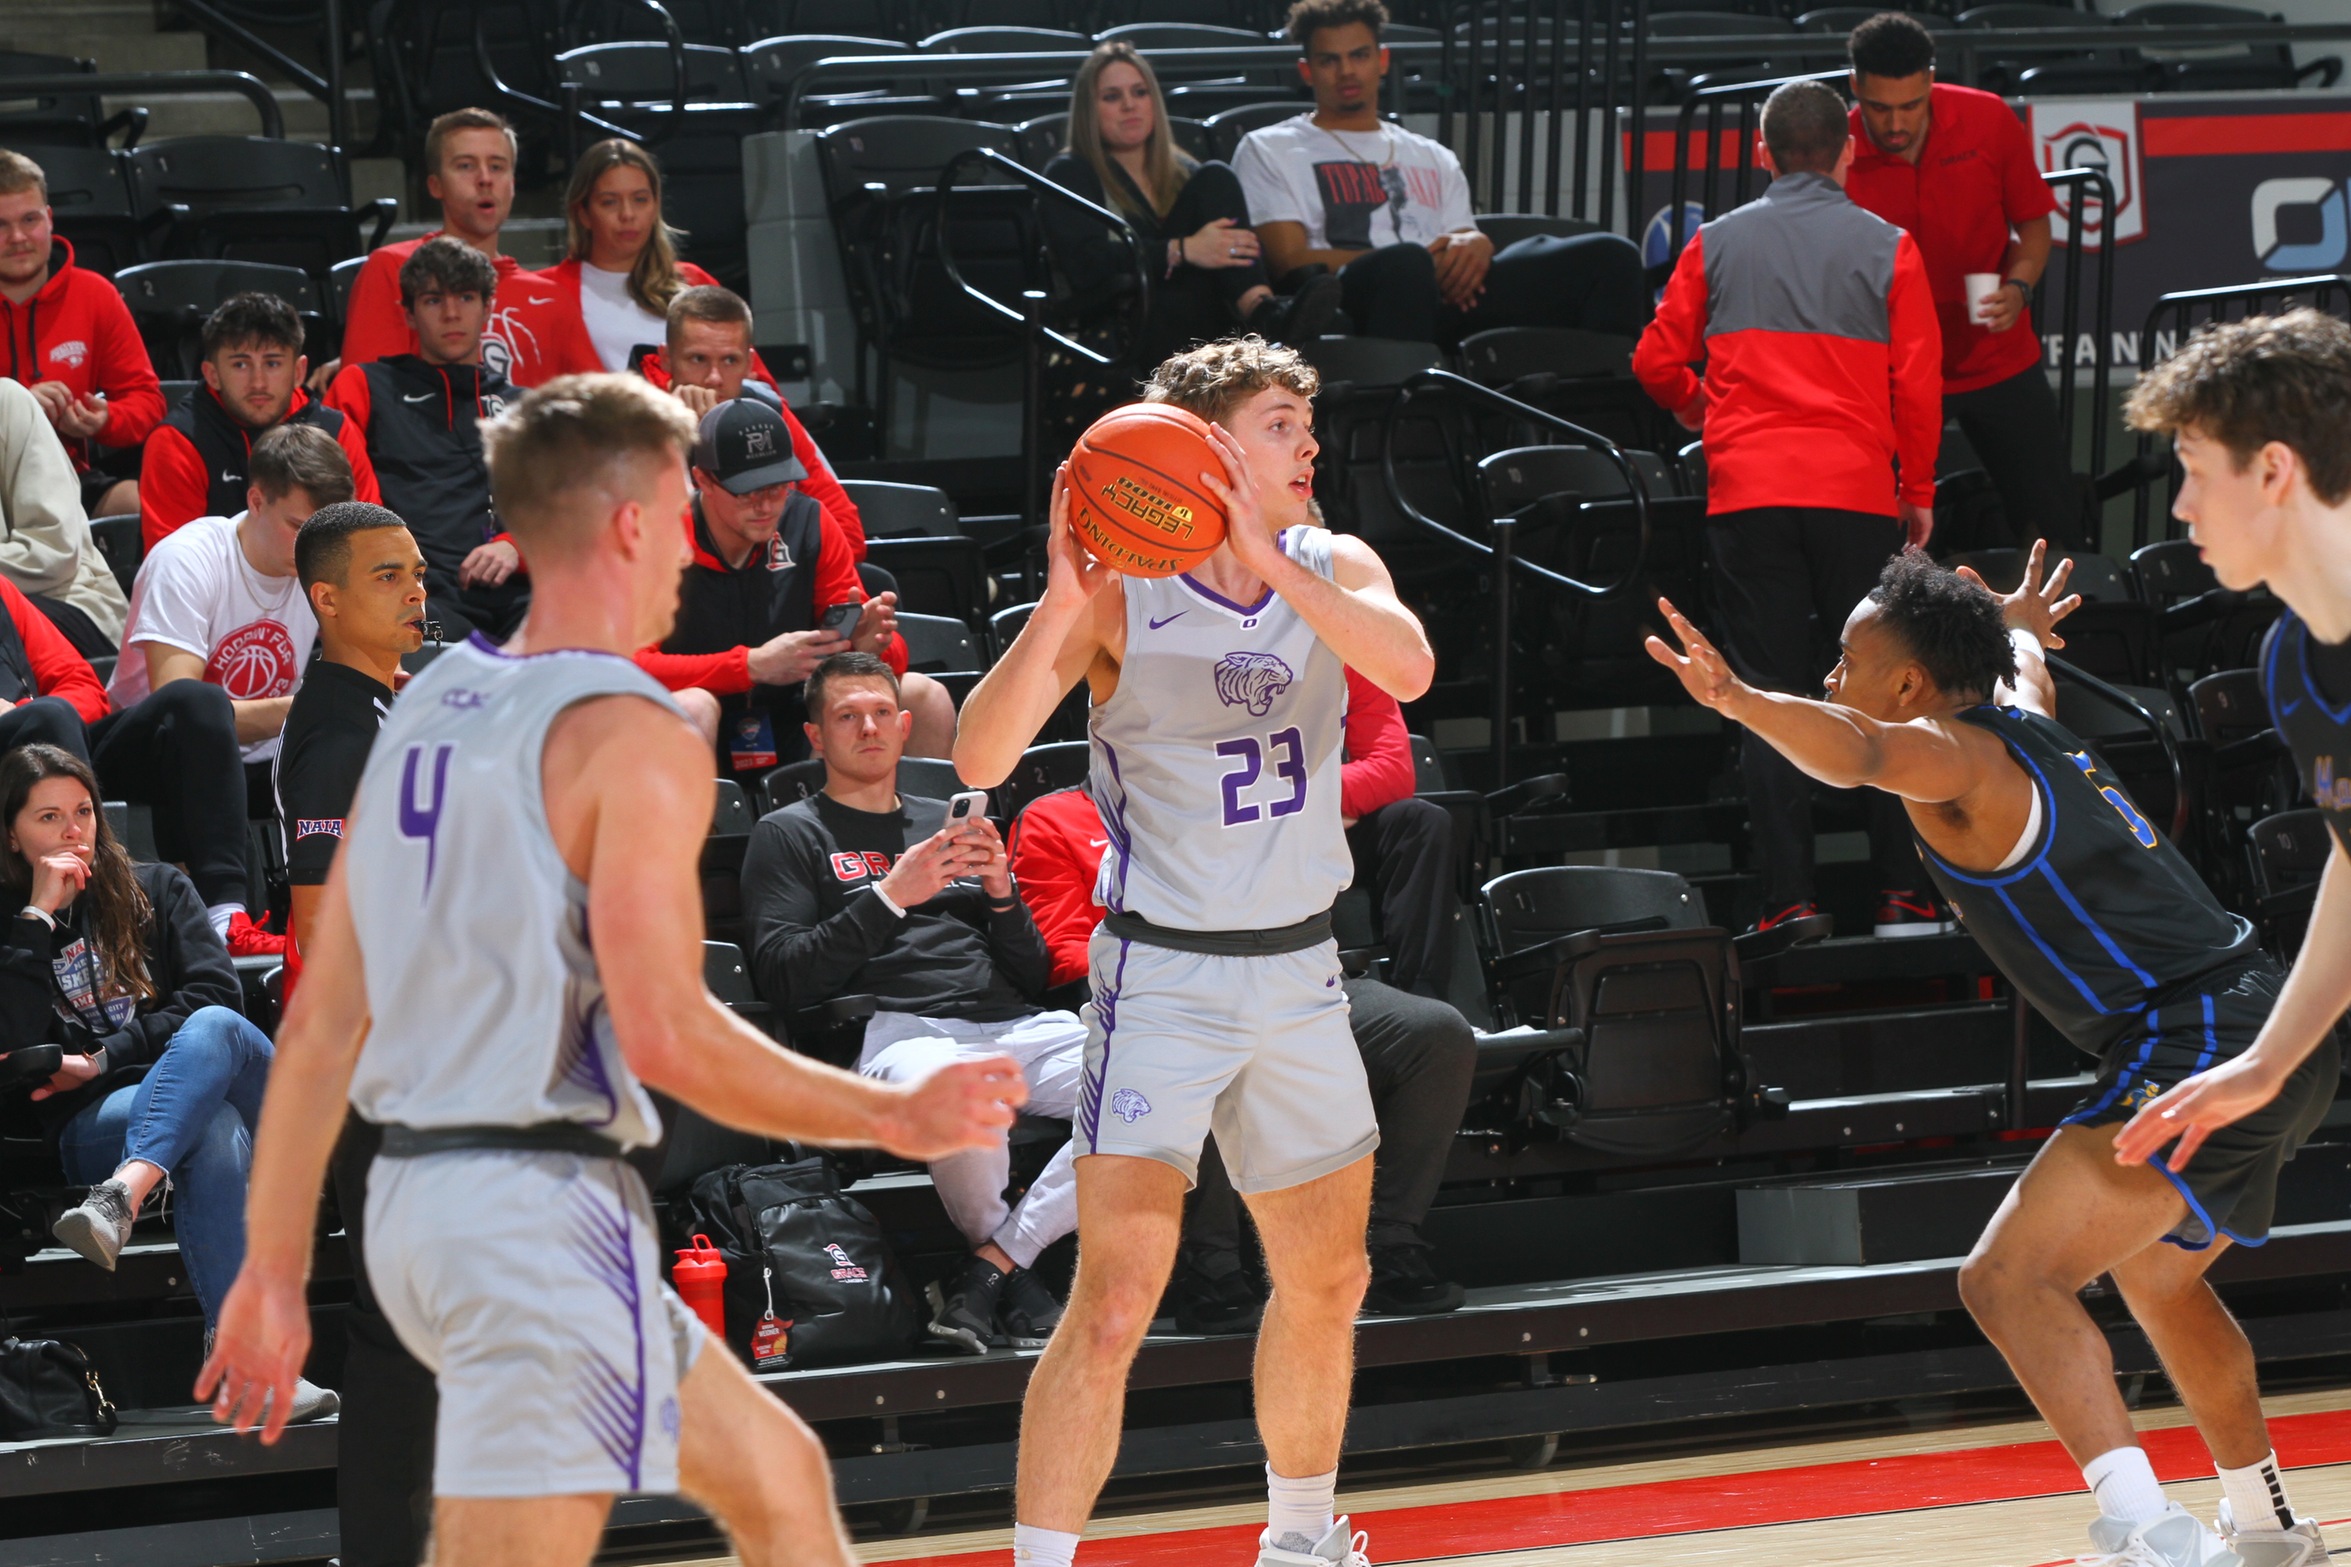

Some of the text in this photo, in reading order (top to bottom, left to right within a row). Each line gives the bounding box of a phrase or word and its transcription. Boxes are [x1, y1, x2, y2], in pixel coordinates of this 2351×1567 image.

[1101, 483, 1196, 541] LEGACY
[1117, 476, 1174, 512] 1000
[1076, 507, 1184, 572] SPALDING
[797, 781, 808, 799] 3
[1213, 724, 1308, 829] 23
[297, 819, 344, 840] NAIA
[396, 741, 458, 908] 4
[108, 1003, 124, 1013] CITY
[830, 1267, 868, 1280] GRACE
